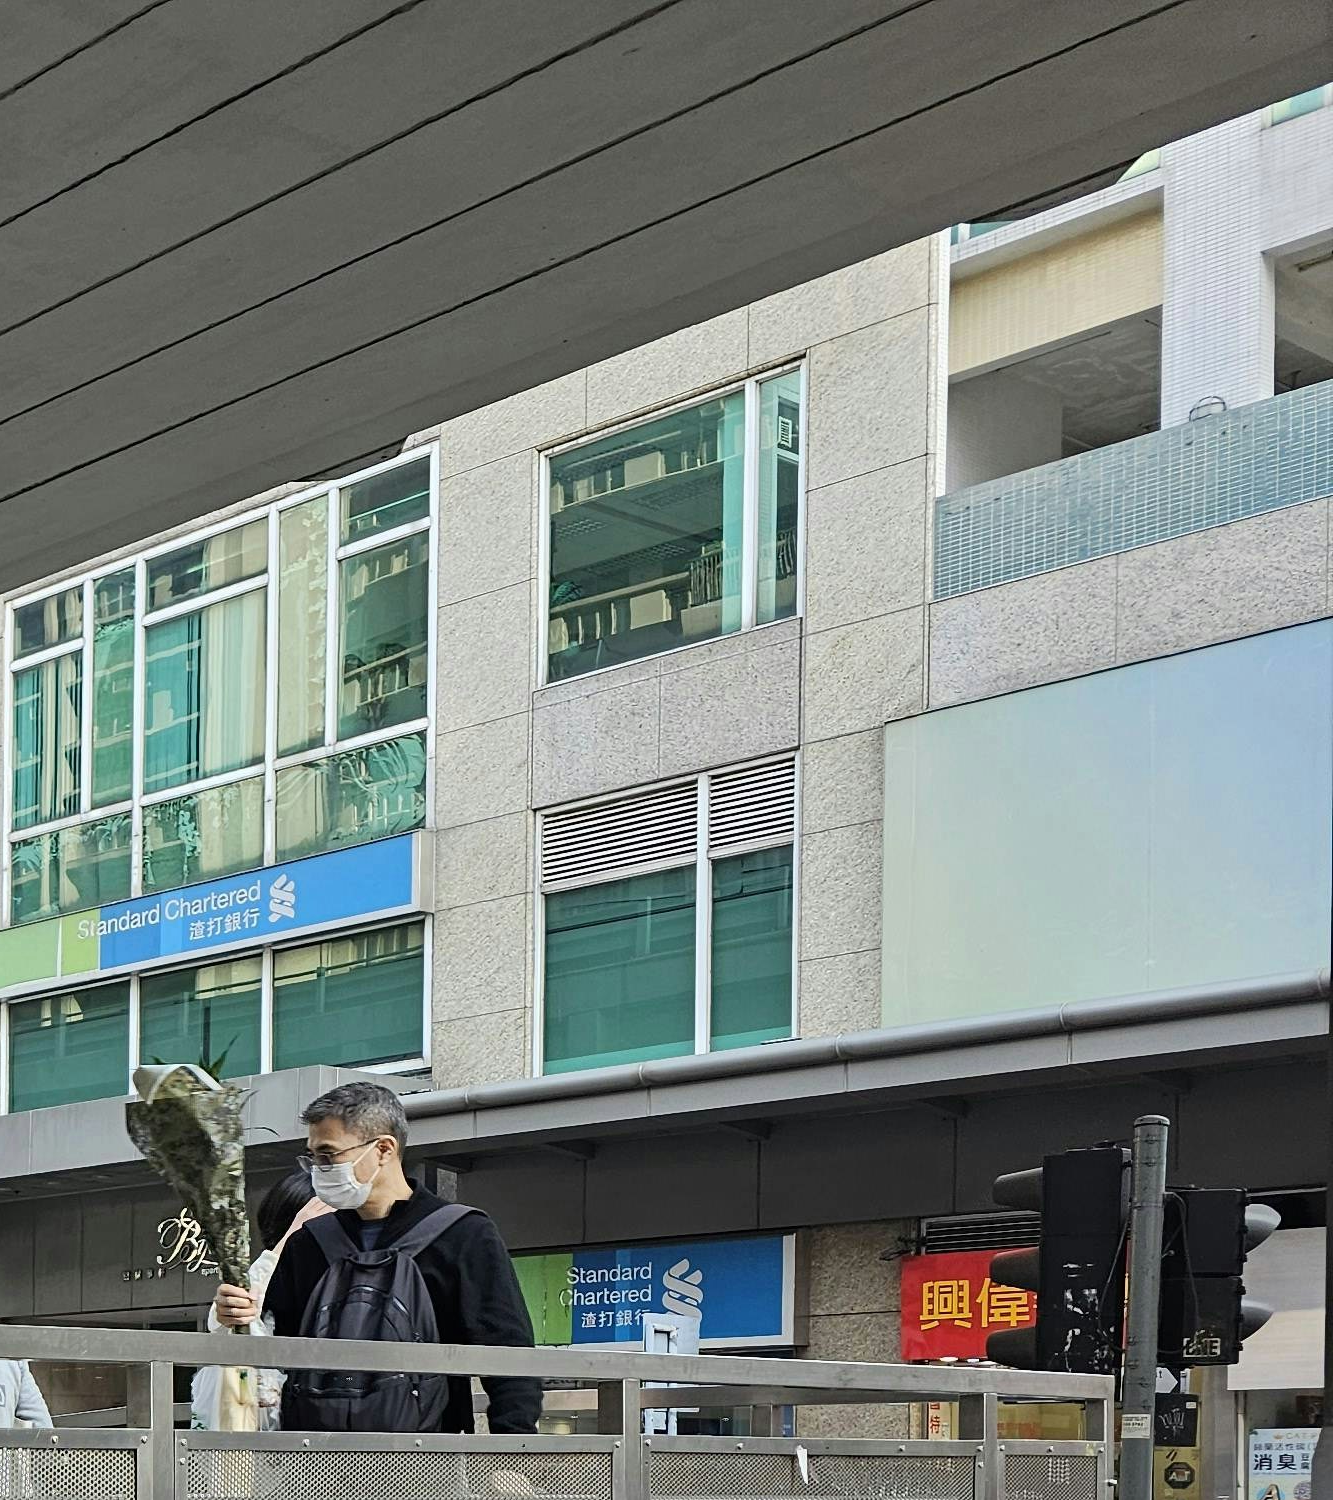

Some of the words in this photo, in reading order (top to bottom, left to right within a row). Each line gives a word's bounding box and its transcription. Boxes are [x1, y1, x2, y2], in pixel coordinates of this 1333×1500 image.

[77, 906, 160, 940] Standard
[164, 880, 261, 920] Chartered
[189, 907, 261, 941] 渣打銀行
[566, 1262, 652, 1285] Standard
[560, 1284, 652, 1307] Chartered
[919, 1277, 1037, 1331] 興偉
[1253, 1453, 1297, 1471] 消臭
